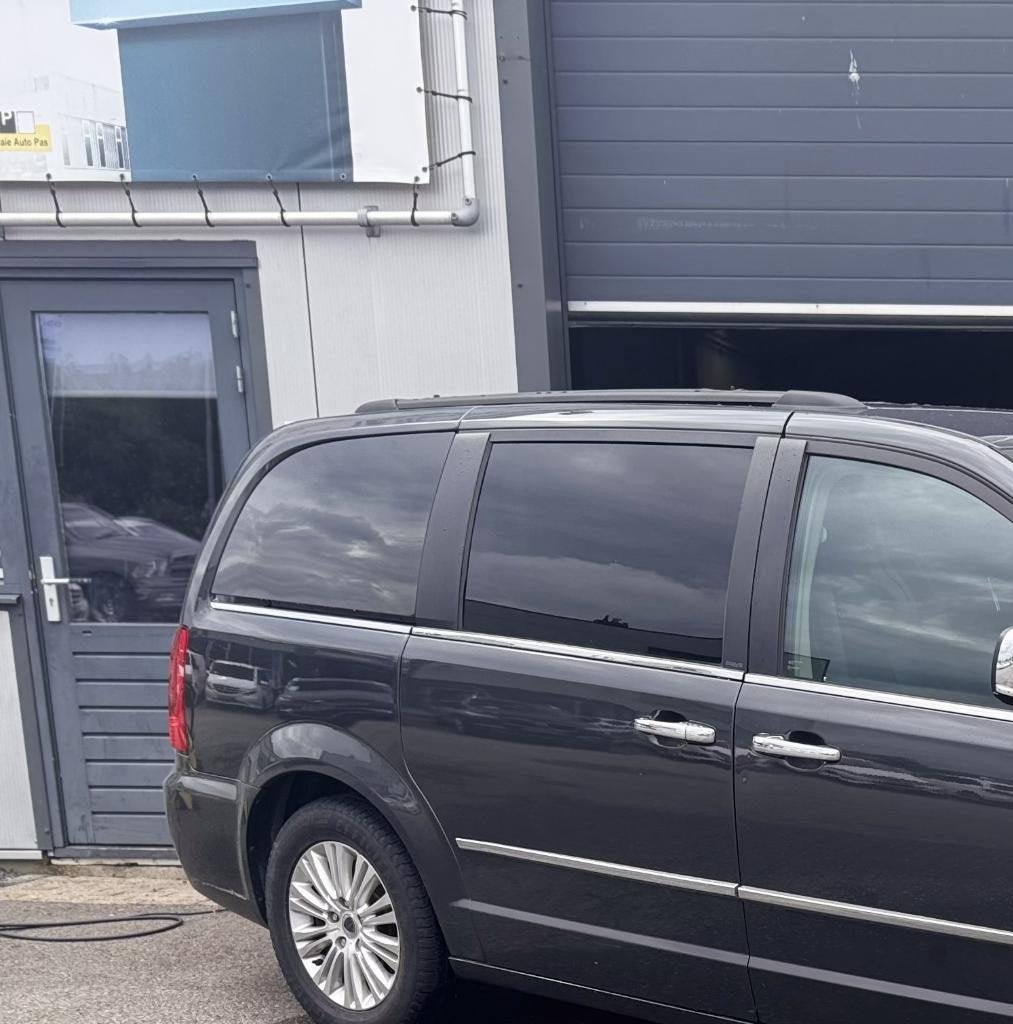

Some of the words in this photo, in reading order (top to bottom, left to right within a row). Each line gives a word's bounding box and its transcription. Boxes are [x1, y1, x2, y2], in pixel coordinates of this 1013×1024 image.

[1, 111, 12, 126] P
[14, 137, 32, 147] Auto
[34, 137, 48, 147] Pas
